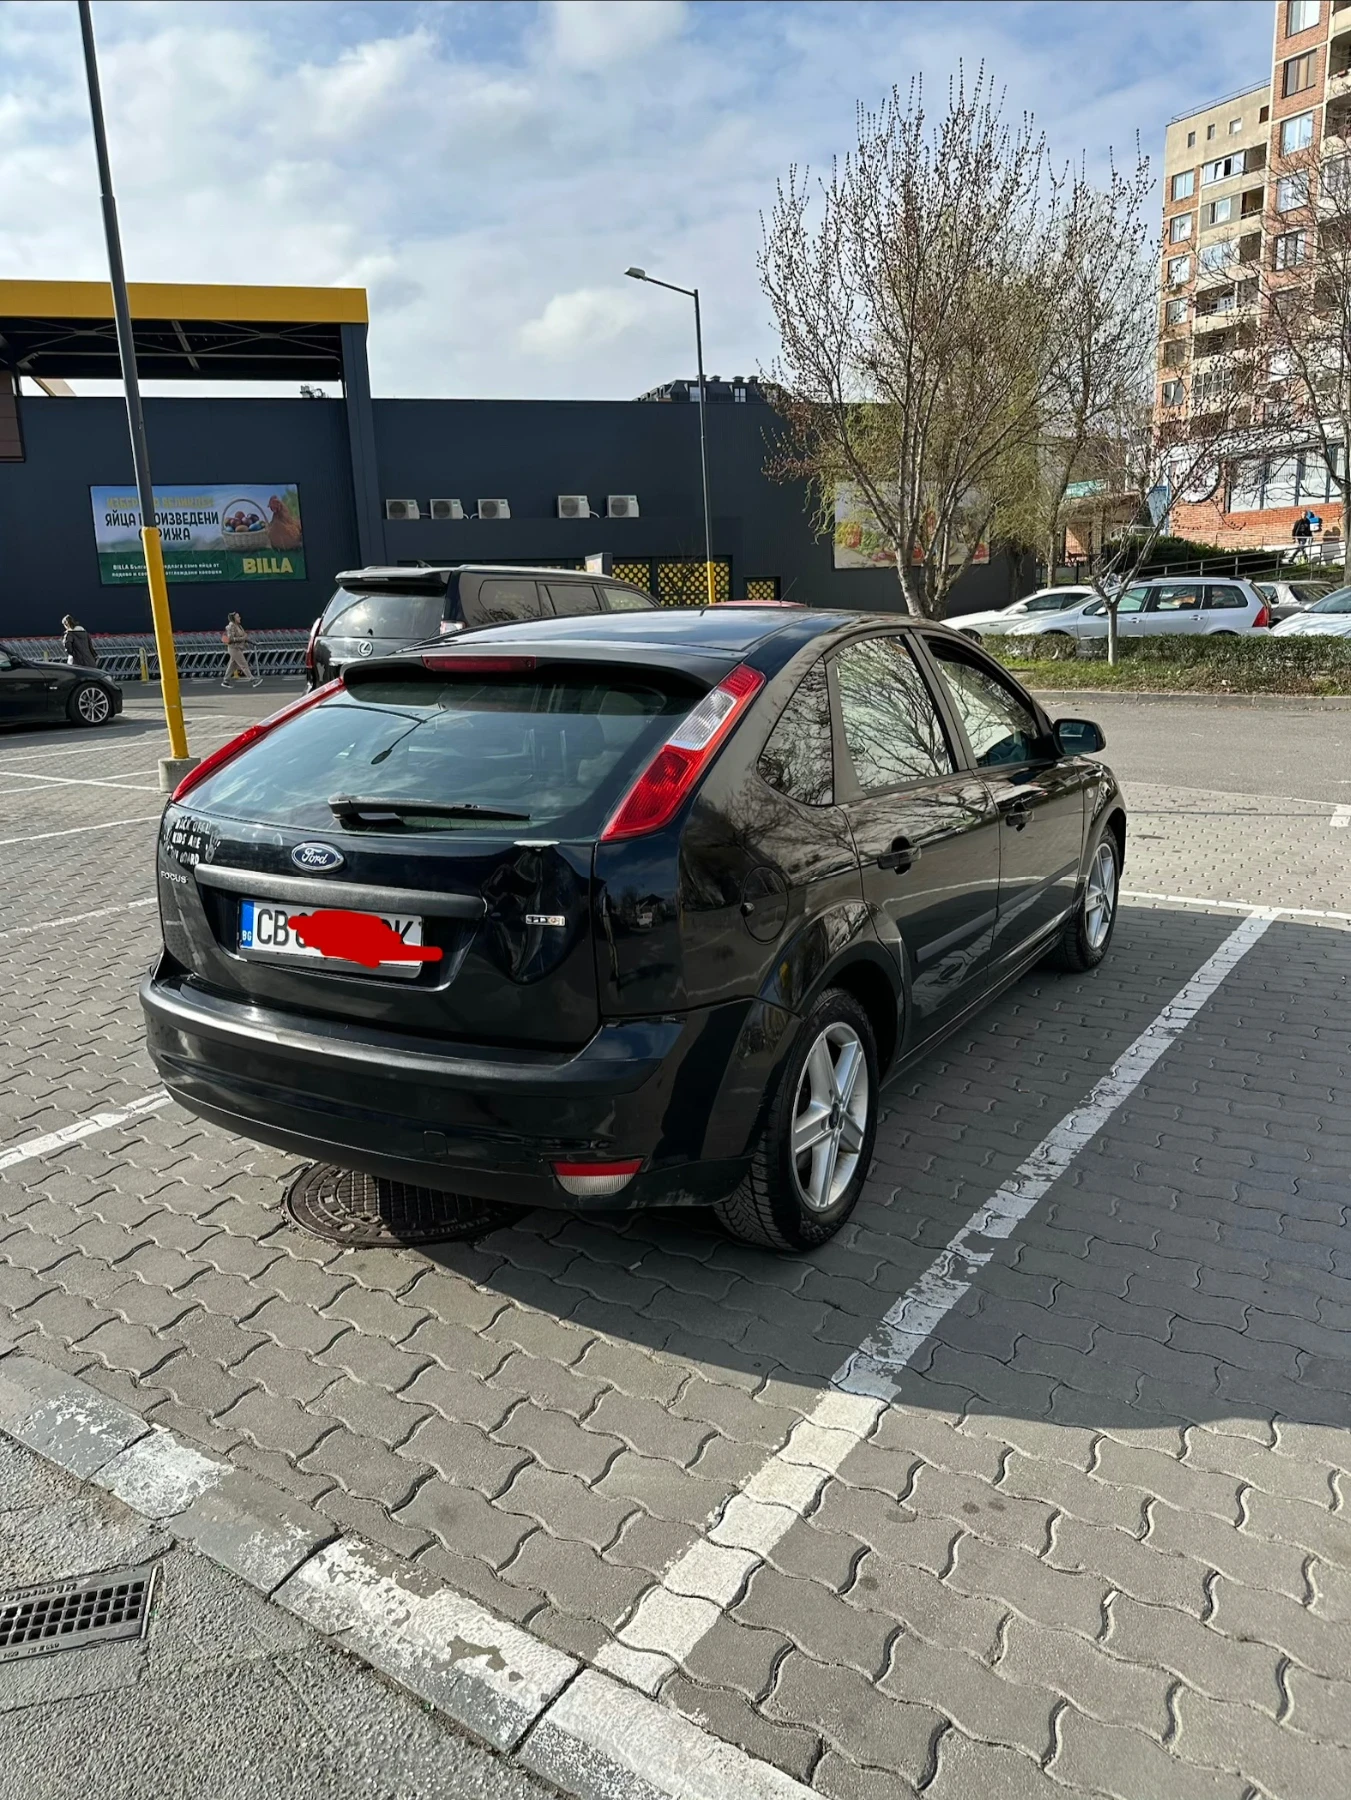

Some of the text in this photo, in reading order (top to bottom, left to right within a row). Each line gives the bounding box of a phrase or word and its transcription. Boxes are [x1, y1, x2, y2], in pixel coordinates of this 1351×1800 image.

[105, 509, 219, 528] ЯЙЦА ОИЗВЕДЕНИ
[156, 527, 191, 541] РИЖА
[242, 557, 294, 574] BILLA
[301, 847, 329, 864] Ford
[160, 870, 188, 884] FOCUS
[257, 908, 290, 945] CB
[242, 930, 252, 941] BG
